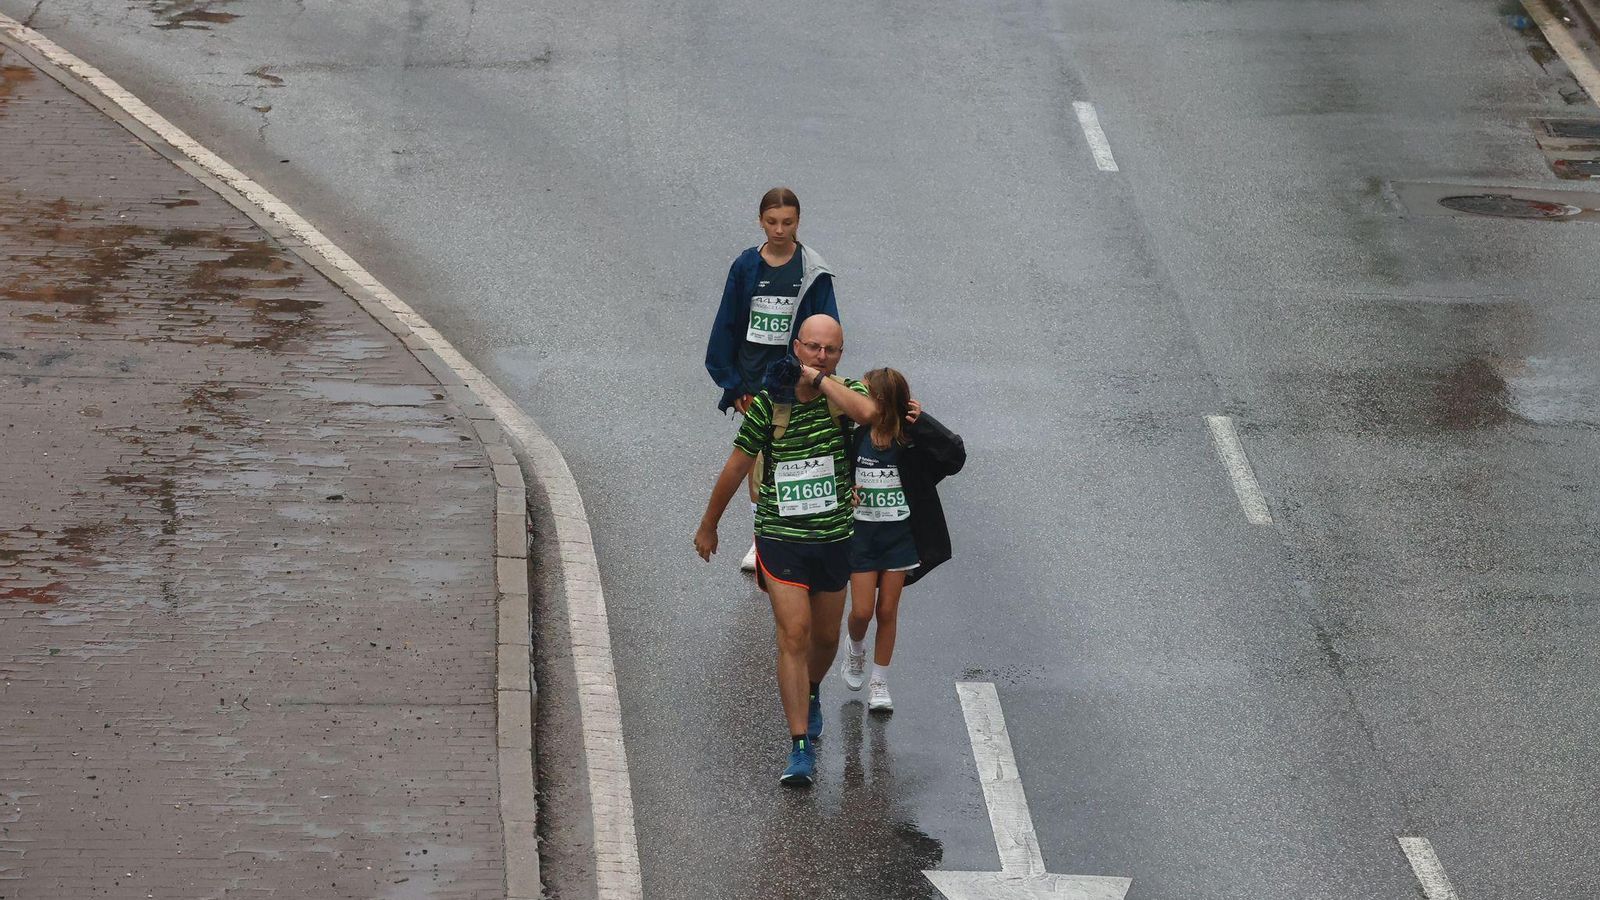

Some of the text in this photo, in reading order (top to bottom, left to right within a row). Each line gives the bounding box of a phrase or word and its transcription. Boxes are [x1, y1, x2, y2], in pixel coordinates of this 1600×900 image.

[753, 315, 791, 332] 2165
[781, 480, 833, 501] 21660
[859, 491, 906, 507] 21659
